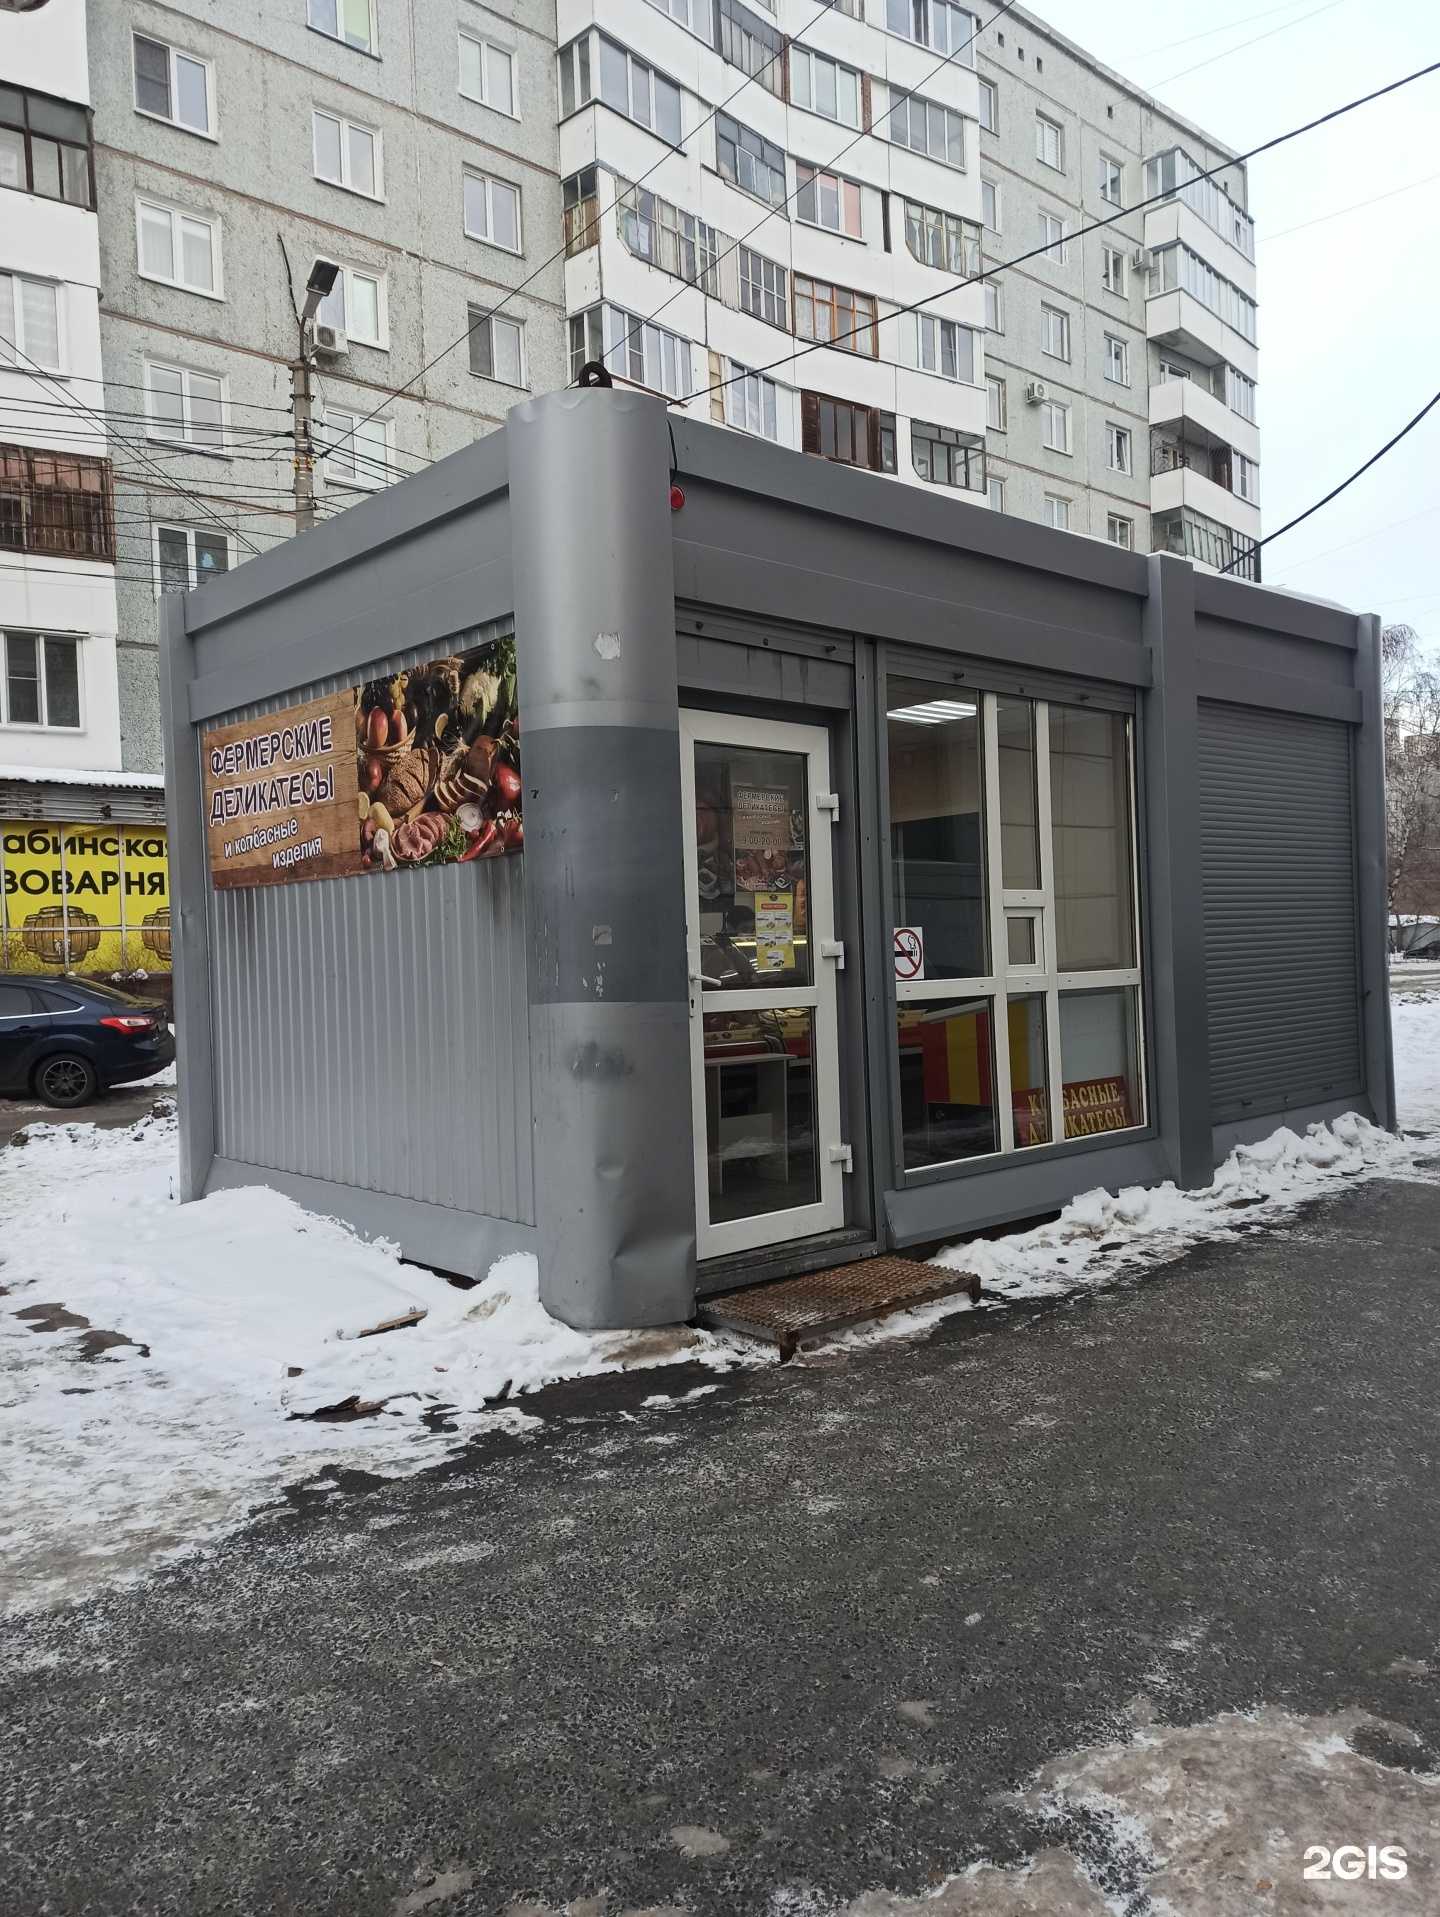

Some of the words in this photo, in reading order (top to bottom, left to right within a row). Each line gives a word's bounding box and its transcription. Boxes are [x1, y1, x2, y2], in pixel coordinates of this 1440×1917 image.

[211, 716, 332, 777] ФЕРМЕРСКИЕ
[210, 765, 335, 827] ДЕЛИКАТЕСЫ
[224, 842, 233, 859] и
[234, 817, 298, 854] колбасные
[272, 836, 322, 869] изделия
